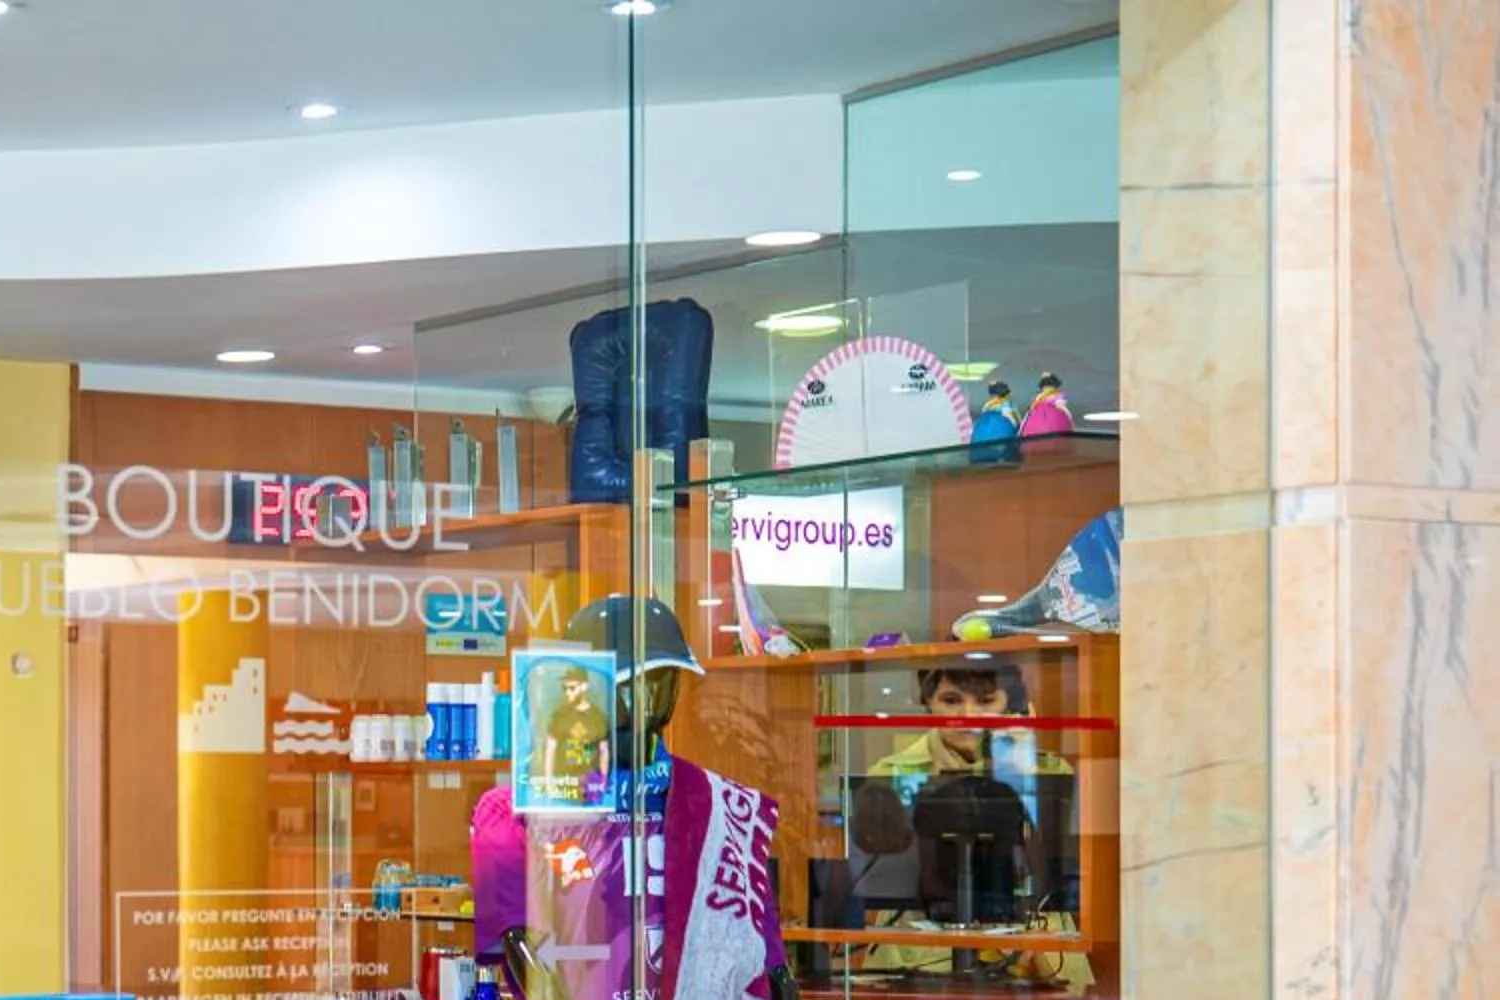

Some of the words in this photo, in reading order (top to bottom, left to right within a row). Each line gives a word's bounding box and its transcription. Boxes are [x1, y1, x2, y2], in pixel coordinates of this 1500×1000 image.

[56, 463, 470, 552] BOUTIQUE
[229, 571, 561, 634] BENIDORM
[133, 910, 165, 926] POR
[168, 909, 219, 925] FAVOR
[222, 907, 292, 924] PREGUNTE
[297, 907, 319, 922] EN
[187, 936, 238, 953] PLEASE
[241, 936, 269, 951] ASK
[192, 964, 273, 981] CONSULTEZ
